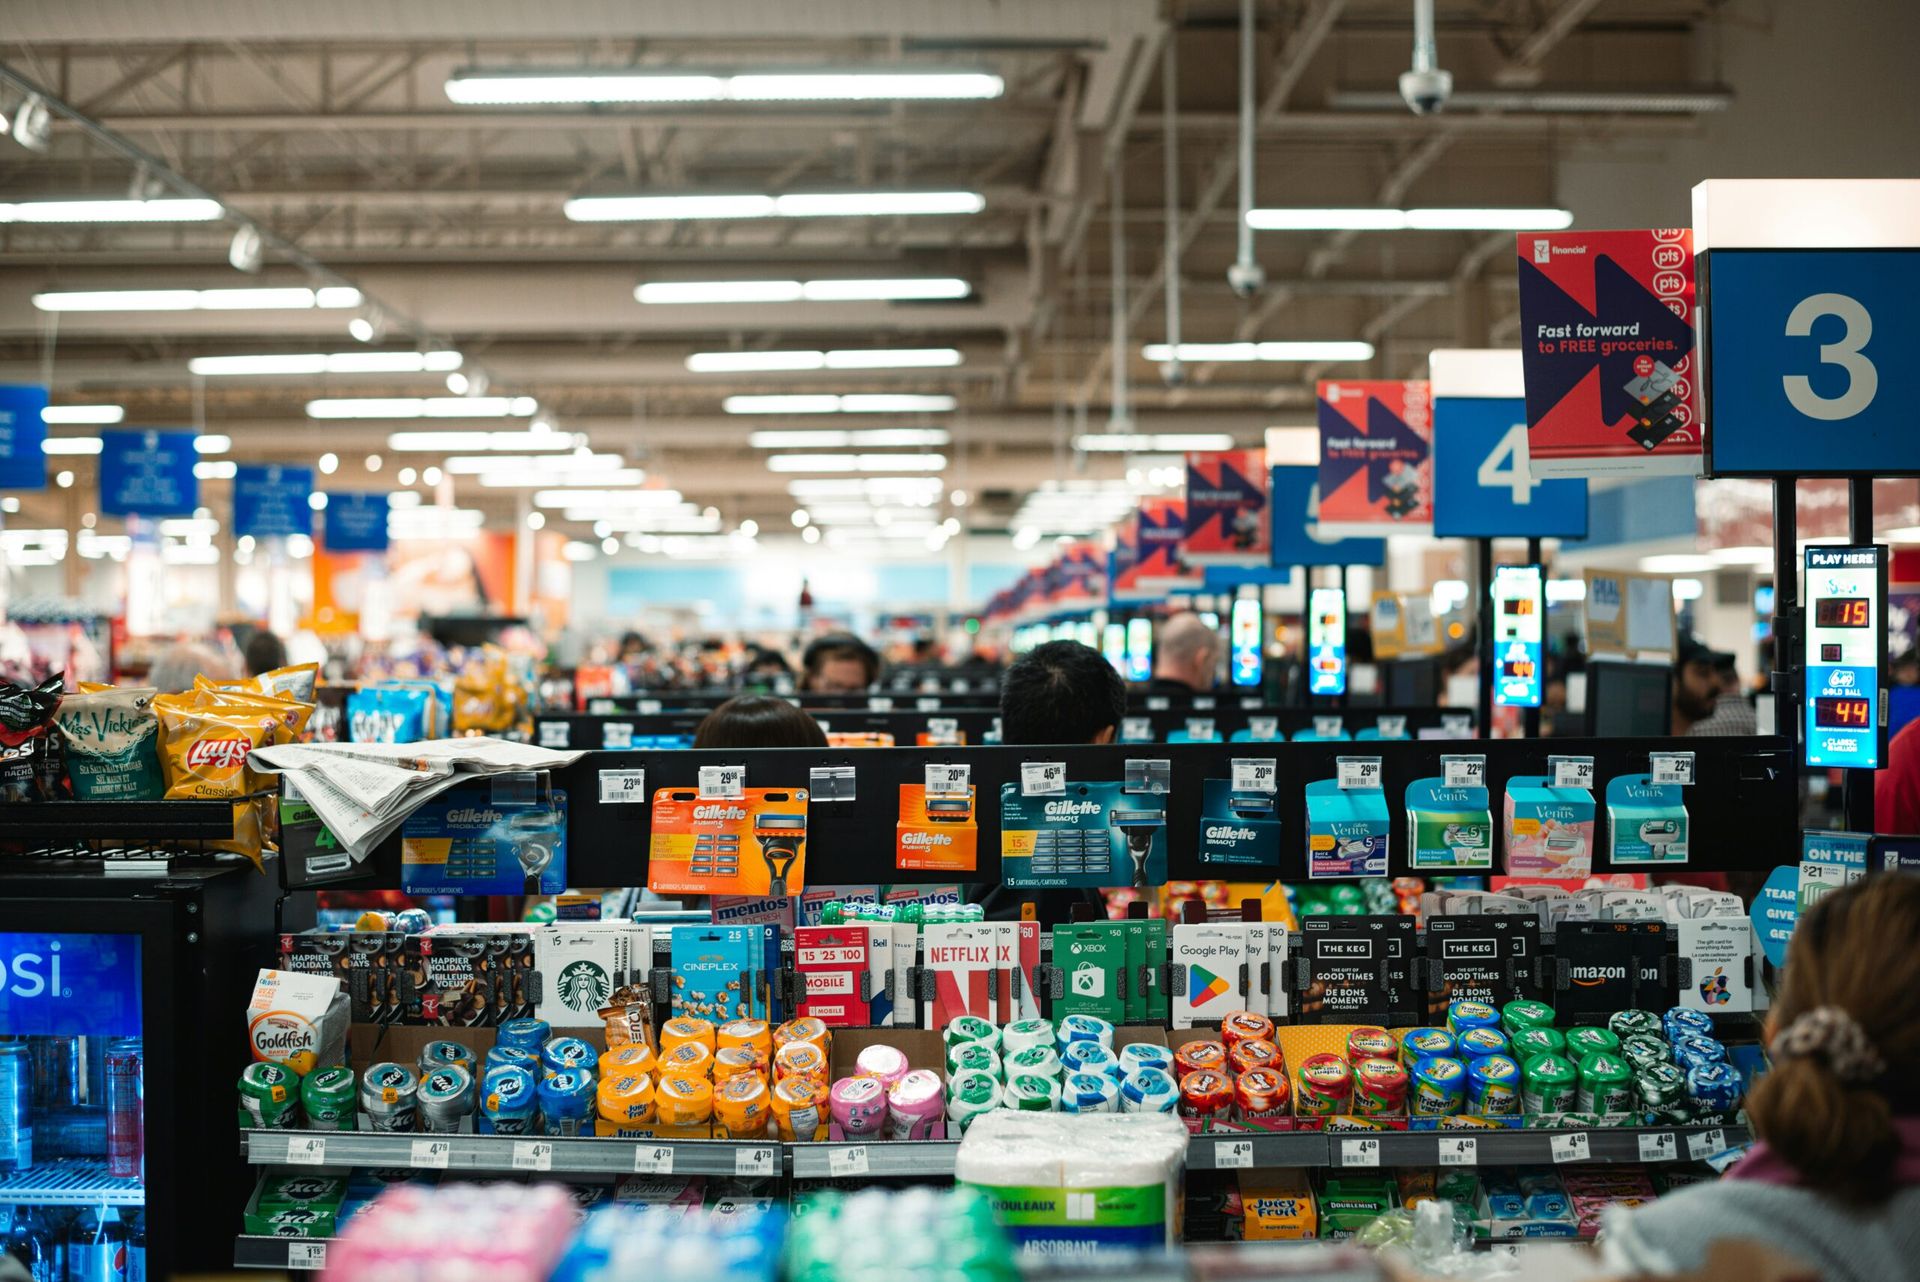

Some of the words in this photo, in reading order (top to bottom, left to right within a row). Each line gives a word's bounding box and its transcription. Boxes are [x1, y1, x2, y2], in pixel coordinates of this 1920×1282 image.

[1552, 246, 1587, 254] financial
[1659, 248, 1679, 265] pts
[1660, 274, 1680, 291] pts
[1538, 324, 1571, 338] Fast
[1577, 322, 1640, 338] forward
[1538, 341, 1555, 354] to
[1559, 339, 1597, 353] FREE
[1601, 337, 1678, 356] groceries.
[1783, 293, 1878, 420] 3
[1478, 424, 1541, 505] 4
[1812, 554, 1842, 565] PLAY
[1844, 553, 1874, 564] HERE
[1843, 601, 1866, 625] 15
[1822, 688, 1842, 696] GOLD
[1845, 688, 1861, 696] BALL
[1836, 702, 1868, 723] 44
[195, 785, 234, 797] Classic
[1430, 789, 1469, 802] Venus
[1626, 785, 1664, 798] Venus
[693, 805, 746, 820] Gillette
[1044, 801, 1101, 815] Gillette
[1536, 806, 1575, 819] Venus
[447, 809, 502, 823] Gillette
[1206, 826, 1257, 841] Gillette
[1331, 823, 1370, 836] Venus
[1470, 827, 1477, 837] 5
[1666, 823, 1674, 832] 5
[901, 832, 953, 846] Gillette
[1366, 837, 1373, 847] 5
[1204, 852, 1210, 862] 5
[1808, 849, 1831, 861] ON
[1834, 851, 1864, 862] THE
[901, 858, 906, 868] 4
[1803, 865, 1822, 878] $21
[1007, 878, 1015, 886] 15
[1765, 888, 1796, 900] TEAR
[716, 898, 788, 920] mentos
[1766, 909, 1794, 920] GIVE
[728, 931, 742, 939] 25
[1250, 929, 1263, 938] $25
[1269, 928, 1284, 937] $50
[1770, 929, 1793, 940] GET
[873, 939, 887, 947] Bell
[1083, 945, 1106, 953] XBOX
[931, 947, 989, 963] NETFLIX
[1180, 945, 1216, 957] Google
[1219, 945, 1239, 957] Play
[291, 954, 329, 962] HAPPIER
[431, 957, 469, 965] HAPPIER
[289, 961, 333, 969] HOLIDAYS
[429, 964, 472, 972] HOLIDAYS
[683, 963, 738, 971] CINEPLEX
[427, 973, 474, 981] MEILLEURS
[1472, 972, 1499, 980] TIMES
[436, 980, 465, 988] VOEUX
[805, 978, 844, 987] MOBILE
[1466, 988, 1491, 996] BONS
[1460, 1005, 1490, 1014] Trident
[256, 1030, 314, 1050] Goldfish
[1366, 1063, 1396, 1072] Trident
[383, 1068, 404, 1087] excel
[495, 1076, 523, 1094] excel
[1418, 1095, 1455, 1109] Trident
[1327, 1123, 1376, 1132] Trident
[278, 1180, 338, 1193] excel
[1254, 1199, 1296, 1209] Juicy
[1331, 1202, 1377, 1210] DOUBLEMINT
[268, 1211, 330, 1223] excel
[1258, 1207, 1298, 1217] Fruit
[1023, 1240, 1098, 1257] ABSORBANT
